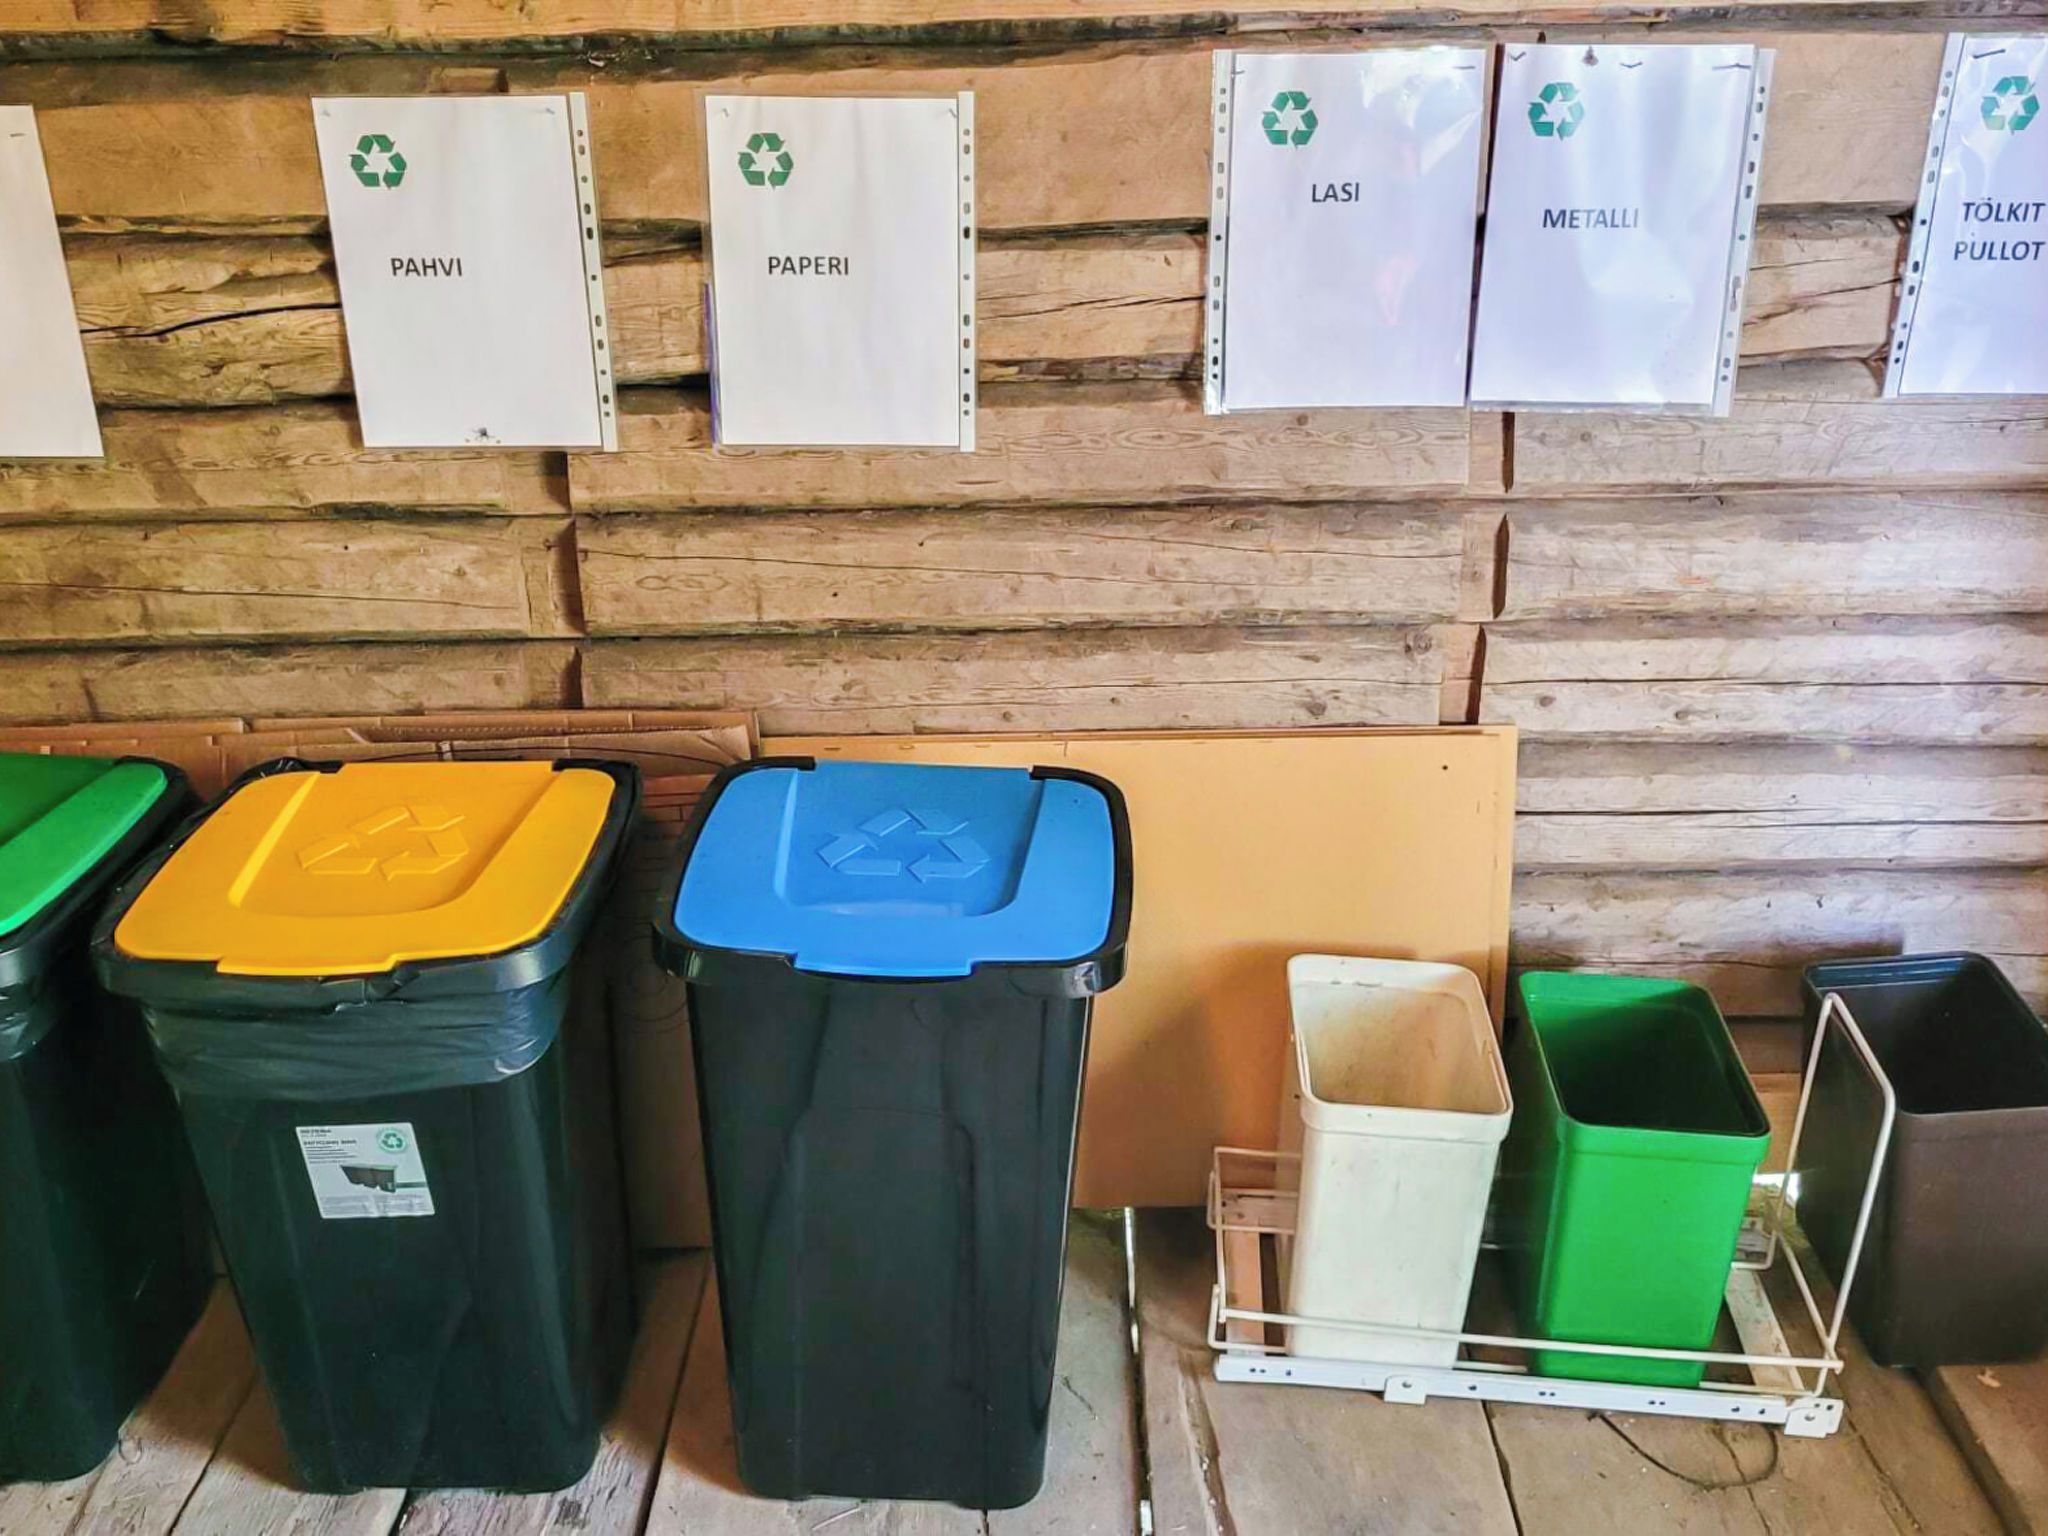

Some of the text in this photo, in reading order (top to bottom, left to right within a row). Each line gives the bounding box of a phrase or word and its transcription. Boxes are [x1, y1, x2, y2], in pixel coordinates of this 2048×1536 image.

[1311, 182, 1361, 203] LASI
[1542, 208, 1639, 230] METALLI
[1962, 197, 2046, 222] TÖLKIT
[1953, 241, 2046, 261] PULLOT
[390, 257, 464, 277] PAHVI
[767, 256, 850, 275] PAPERI
